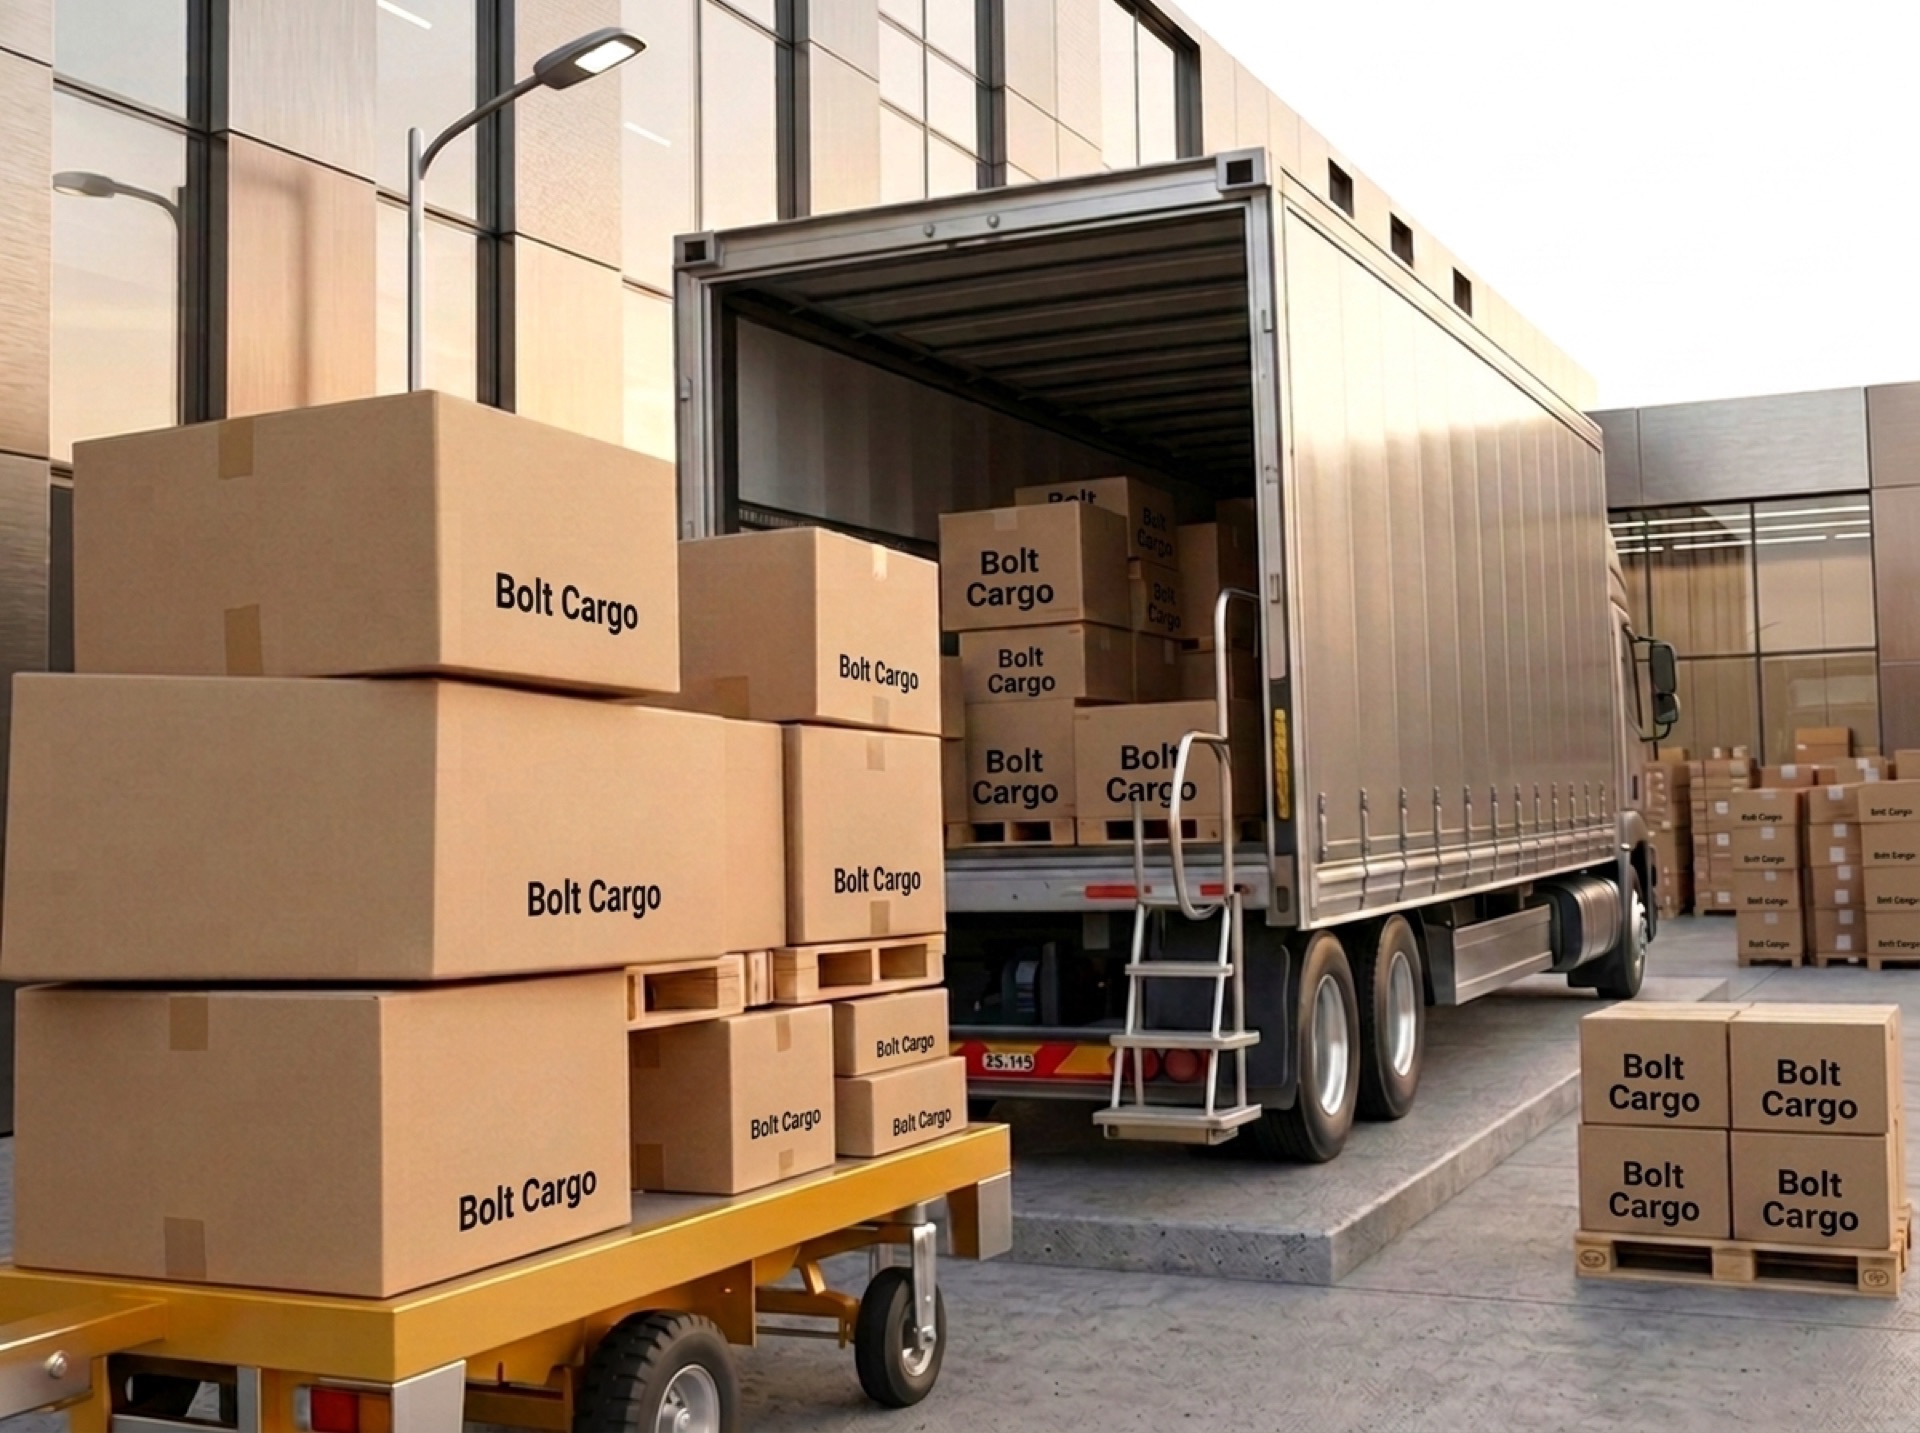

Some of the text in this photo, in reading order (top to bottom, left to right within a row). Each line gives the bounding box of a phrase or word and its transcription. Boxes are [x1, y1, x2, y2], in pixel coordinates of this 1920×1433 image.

[980, 547, 1039, 575] Bolt
[496, 572, 638, 636] Bolt Cargo
[966, 581, 1054, 612] Cargo
[998, 646, 1044, 668] Bolt
[839, 653, 919, 694] Bolt Cargo
[988, 674, 1056, 697] Cargo
[986, 747, 1044, 774] Bolt
[1121, 742, 1179, 770] Bolt
[972, 780, 1059, 809] Cargo
[1106, 776, 1197, 809] Cargo
[834, 866, 921, 897] Bolt Cargo
[527, 877, 662, 919] Bolt Cargo
[876, 1034, 935, 1058] Bolt Cargo
[1623, 1053, 1685, 1081] Bolt
[1777, 1058, 1841, 1087] Bolt
[1609, 1084, 1700, 1118] Cargo
[1762, 1090, 1858, 1126] Cargo
[750, 1108, 822, 1140] Bolt Cargo
[919, 1107, 952, 1129] Cargo
[1623, 1160, 1684, 1189] Bolt
[1778, 1168, 1843, 1198] Bolt
[459, 1170, 597, 1232] Bolt Cargo
[1609, 1191, 1700, 1228] Cargo
[1762, 1200, 1859, 1237] Cargo
